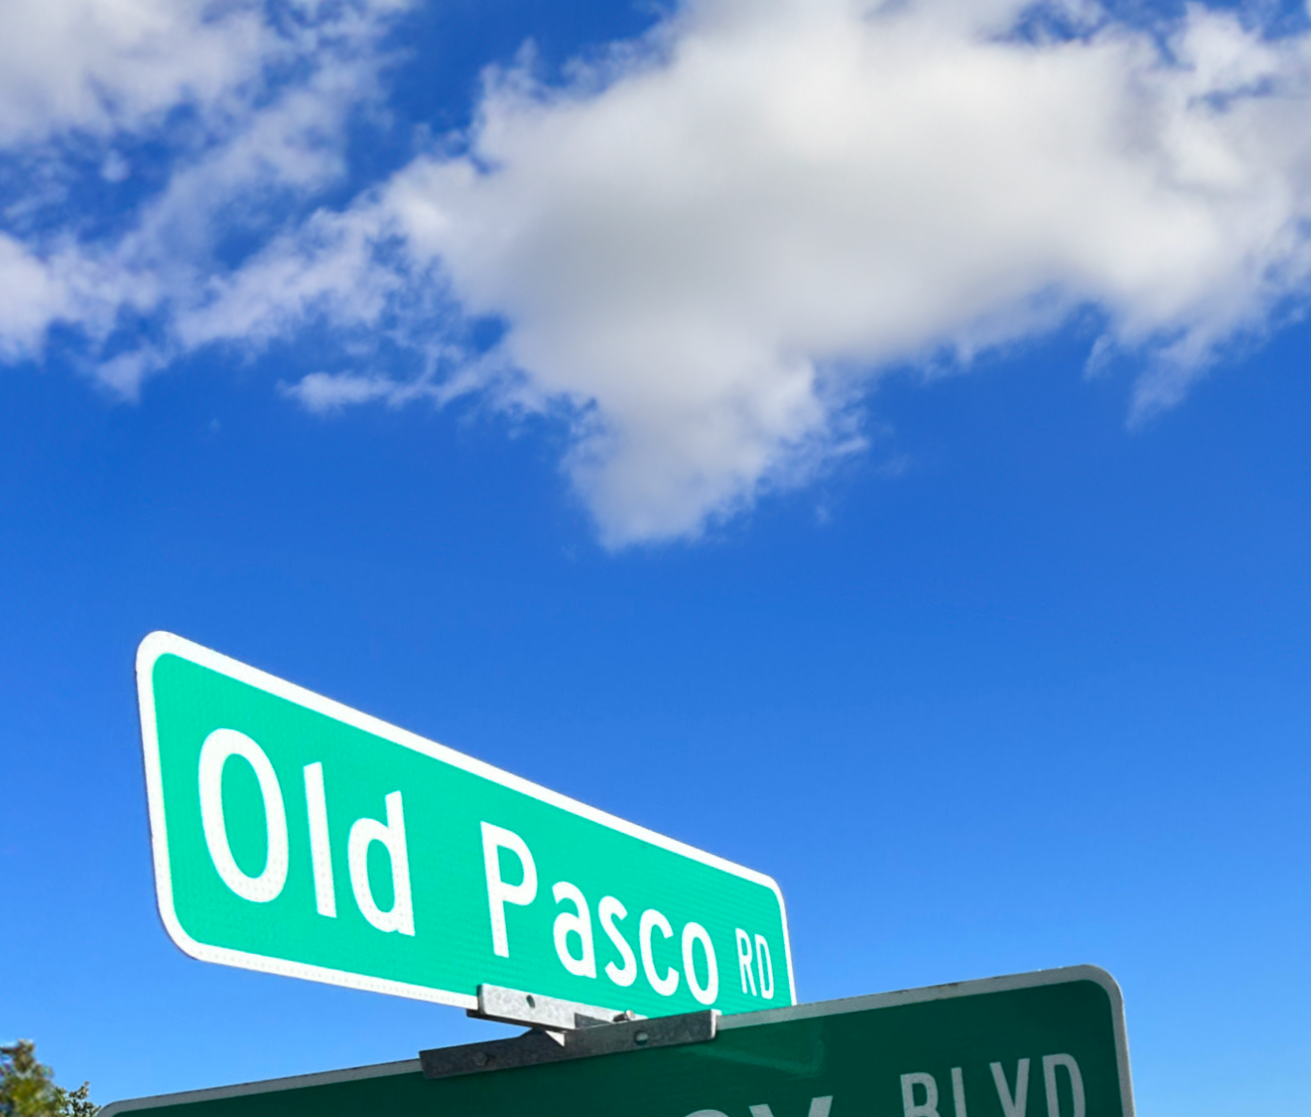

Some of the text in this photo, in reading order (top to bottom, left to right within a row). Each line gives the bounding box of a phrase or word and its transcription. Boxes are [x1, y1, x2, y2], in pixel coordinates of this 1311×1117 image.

[197, 728, 774, 1006] Old Pasco RD
